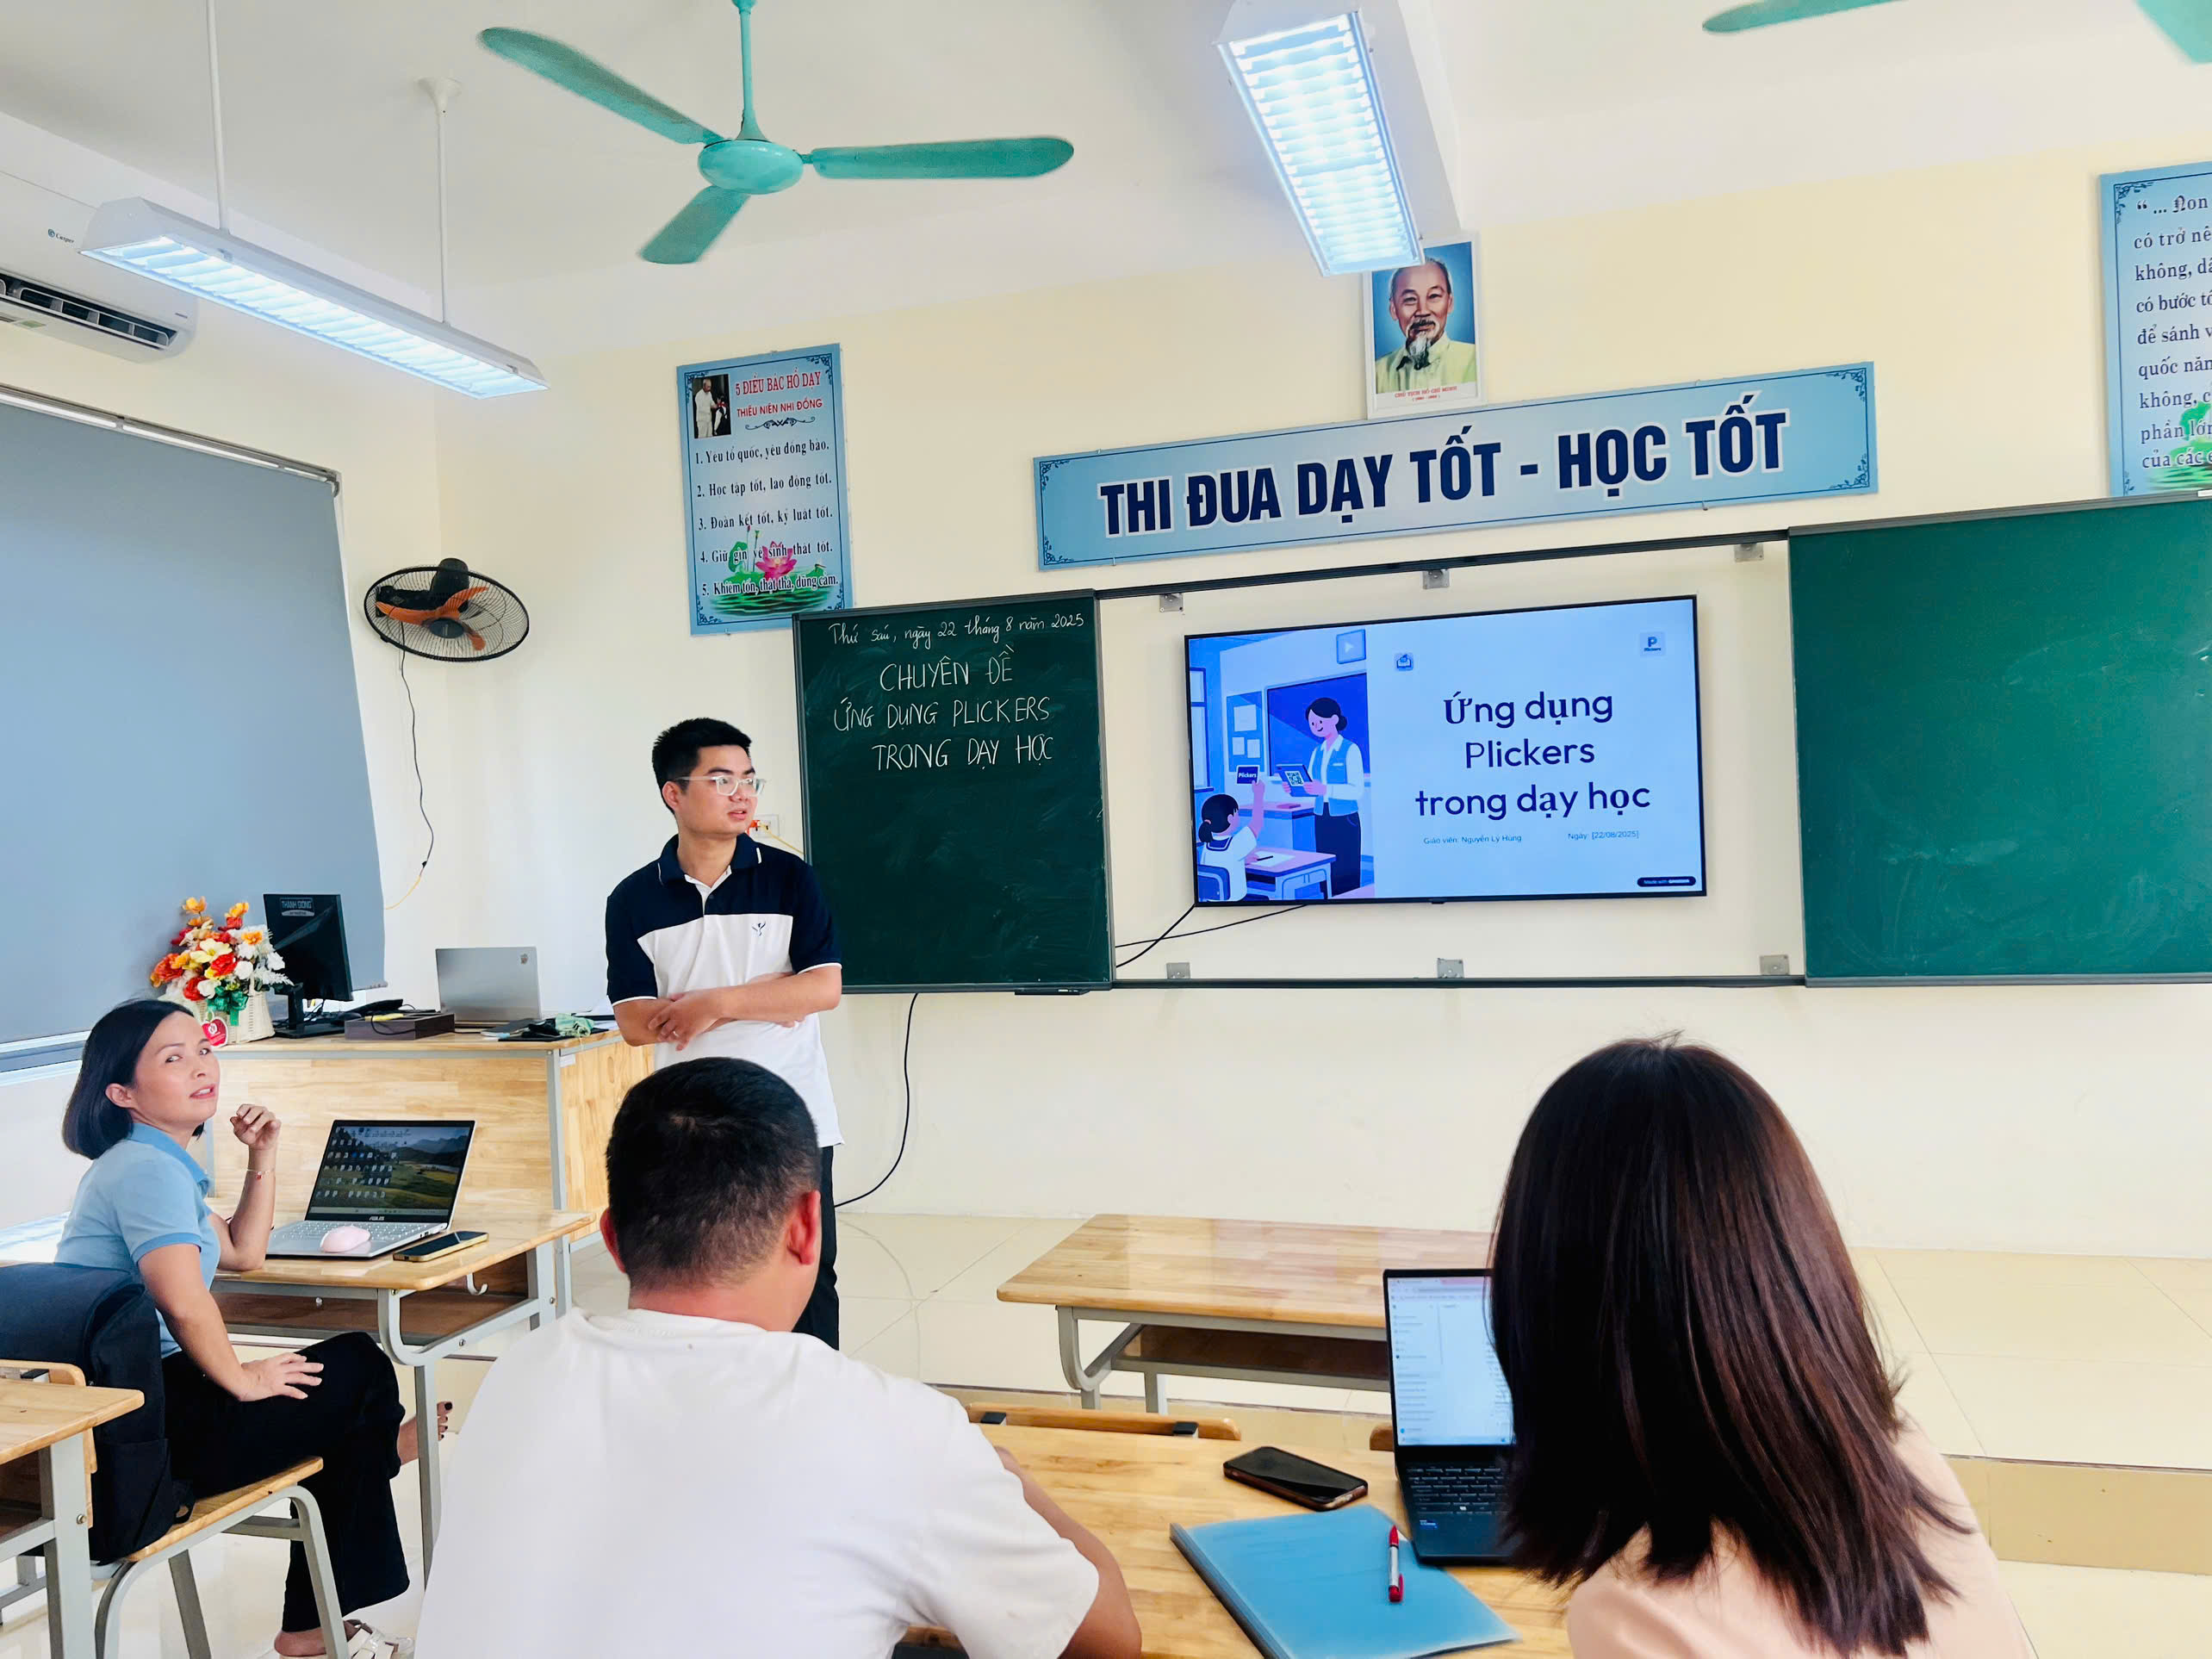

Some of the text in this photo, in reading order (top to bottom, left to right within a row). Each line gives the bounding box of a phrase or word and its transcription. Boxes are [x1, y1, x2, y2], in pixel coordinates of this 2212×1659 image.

[2134, 233, 2153, 249] có
[2159, 227, 2185, 246] trở
[2135, 263, 2192, 281] không,
[2136, 296, 2153, 313] có
[2159, 292, 2196, 310] bước
[2137, 324, 2157, 345] để
[2161, 323, 2199, 342] sánh
[2139, 356, 2178, 380] quốc
[736, 383, 740, 395] 5
[767, 373, 784, 391] BÁC
[802, 371, 821, 389] DẠY
[780, 402, 794, 413] NHI
[2140, 390, 2196, 409] không,
[2141, 419, 2184, 444] phần
[695, 452, 703, 464] 1.
[1100, 479, 1171, 535] THI
[1186, 468, 1282, 527] ĐUA
[1297, 454, 1393, 524] DẠY
[1409, 425, 1501, 504] TỐT
[1557, 425, 1668, 498] HỌC
[1686, 395, 1786, 476] TỐT
[2142, 449, 2171, 469] của
[2177, 448, 2202, 465] các
[697, 486, 705, 497] 2.
[709, 483, 727, 498] Học
[730, 482, 746, 497] tập
[770, 477, 784, 490] lao
[788, 475, 811, 490] động
[699, 519, 706, 531] 3.
[711, 515, 735, 529] Đoàn
[792, 507, 812, 524] luật
[816, 505, 833, 519] tốt.
[700, 550, 708, 563] 4.
[768, 544, 787, 557] sinh
[702, 583, 710, 596] 5.
[828, 622, 859, 644] Thứ
[904, 625, 931, 650] ngày
[937, 621, 958, 637] 22
[964, 614, 1000, 644] tháng
[1005, 616, 1014, 631] 8
[1019, 617, 1045, 631] năm
[1051, 612, 1084, 628] 2025
[879, 643, 1015, 692] CHUYÊN ĐỀ
[833, 696, 874, 731] ỨNG
[887, 701, 939, 730] DỤNG
[1443, 691, 1612, 729] Ứng dụng
[872, 733, 1053, 771] TRONG DẠY HỌC
[1465, 738, 1595, 768] Plickers
[1415, 781, 1650, 821] trong dạy học
